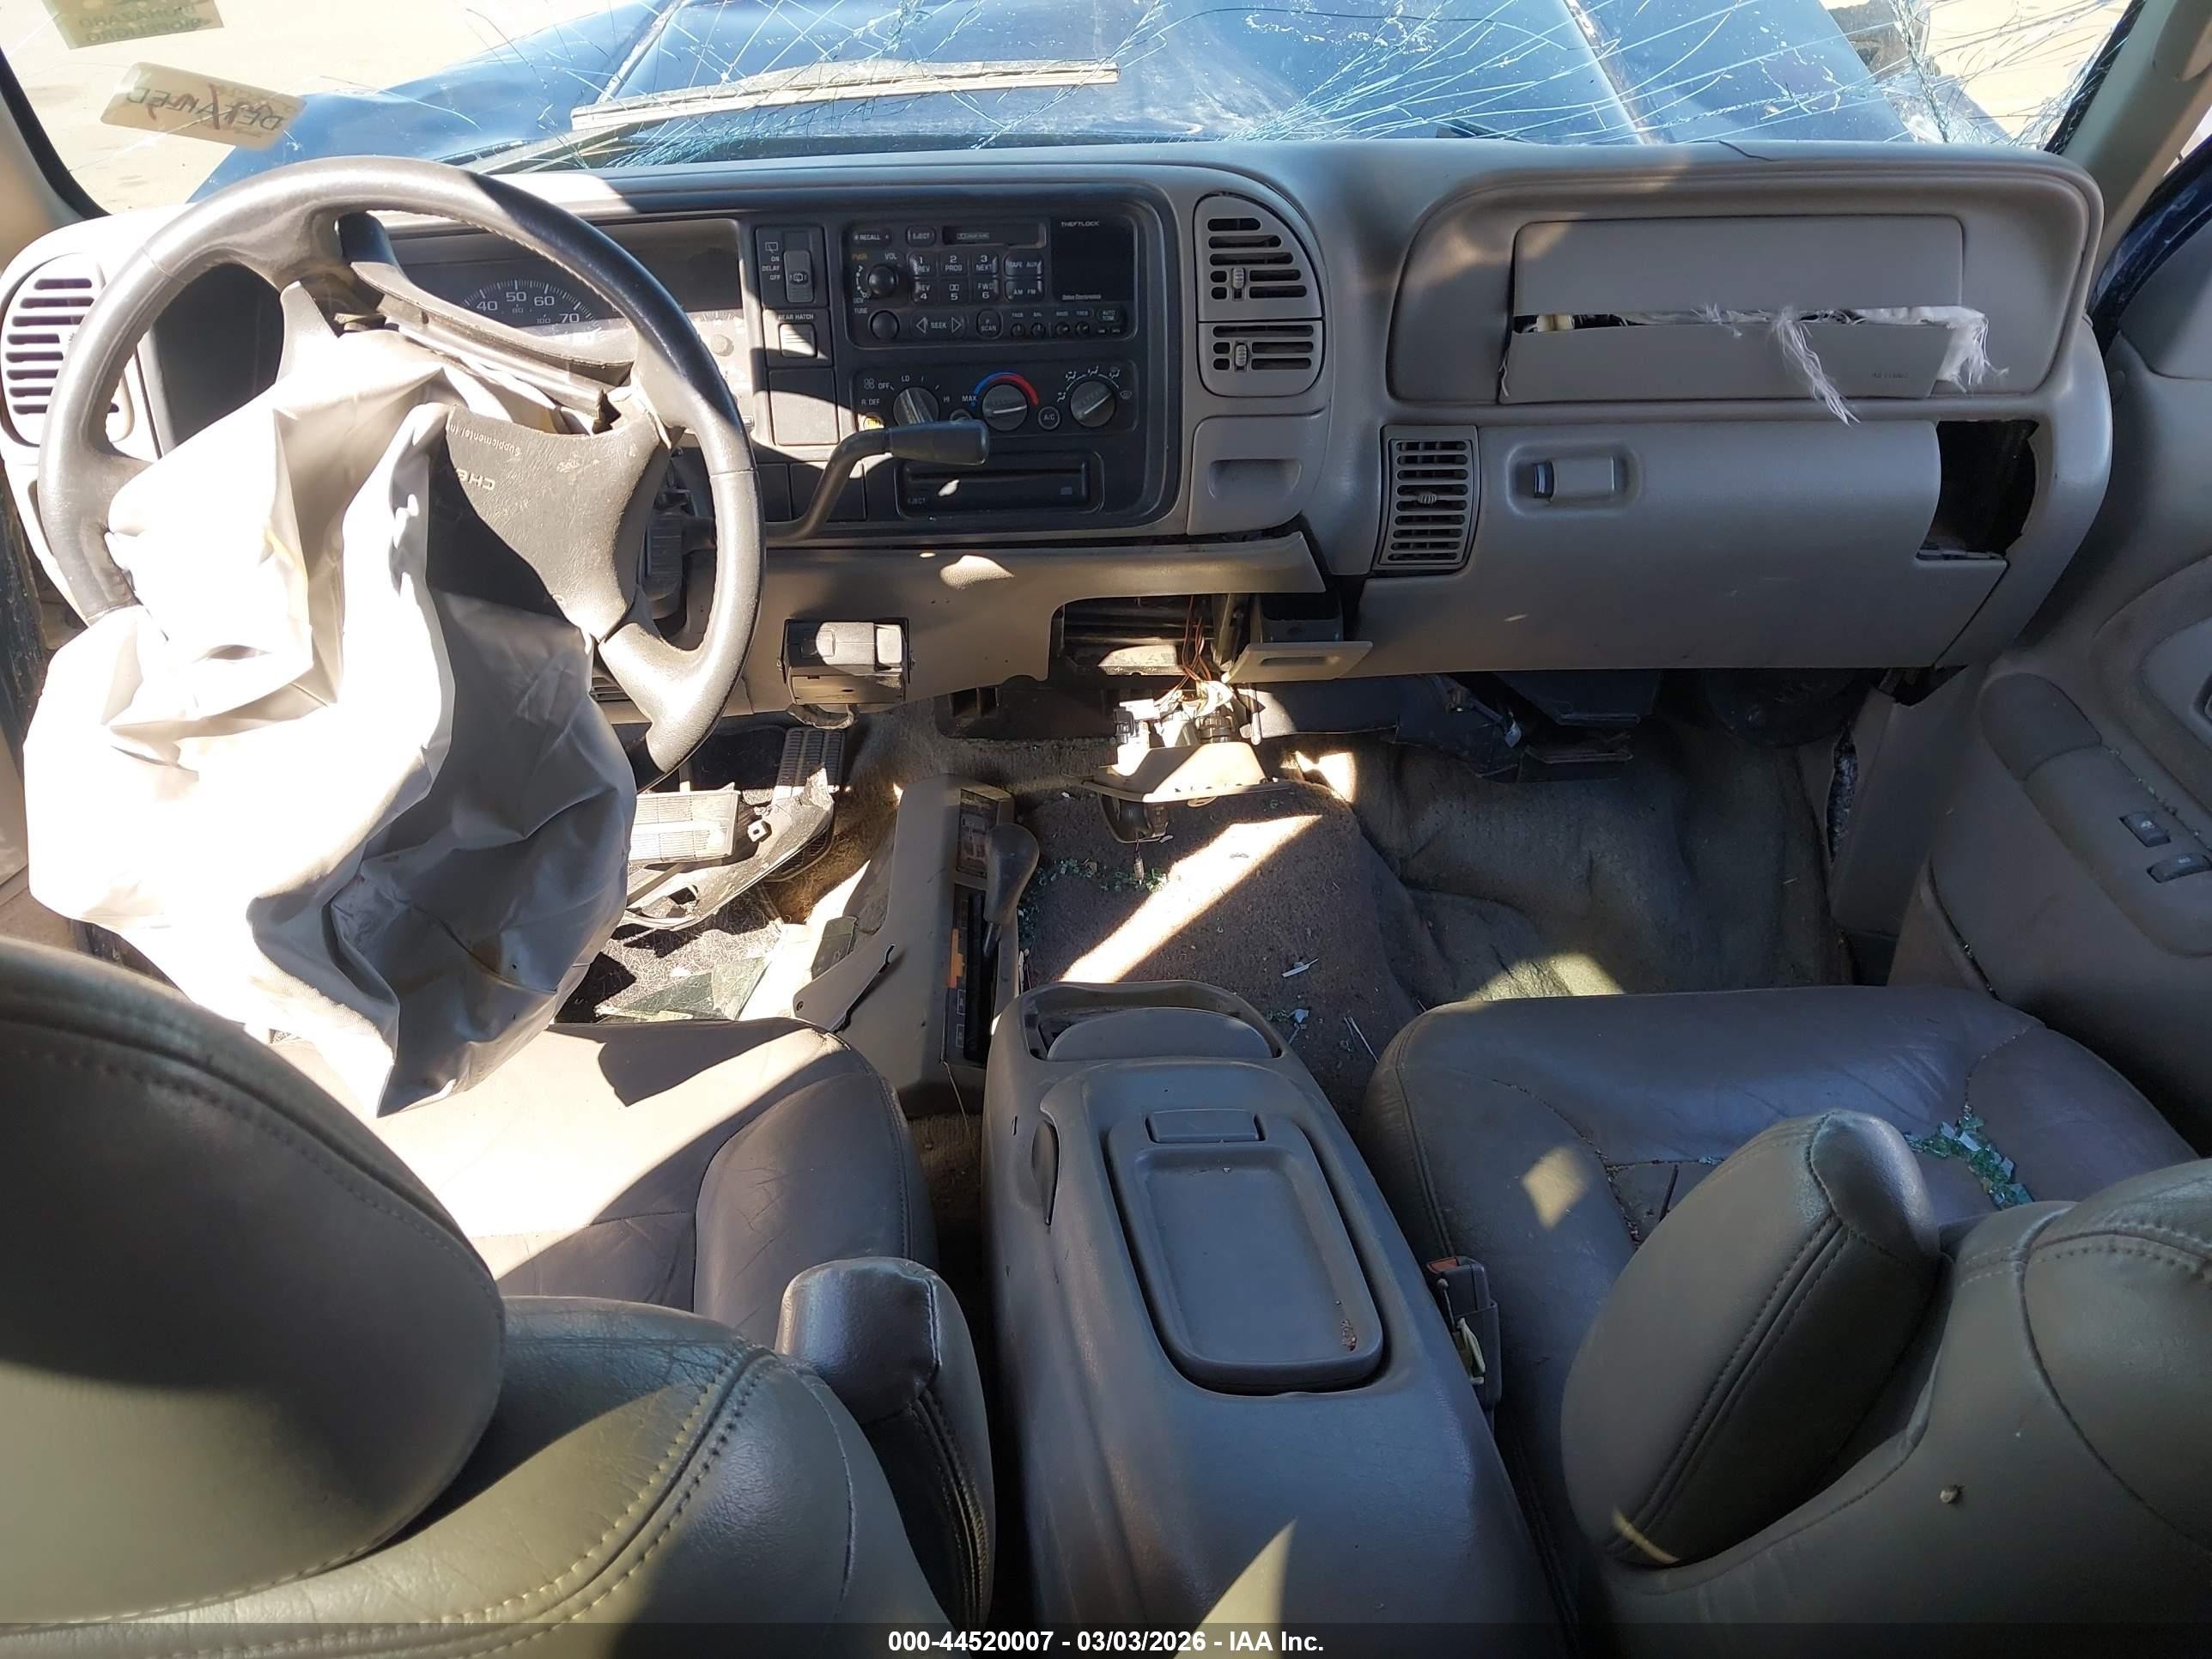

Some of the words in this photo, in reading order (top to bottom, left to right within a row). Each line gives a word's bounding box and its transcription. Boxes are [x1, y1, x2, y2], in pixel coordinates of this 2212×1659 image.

[950, 255, 957, 264] 2
[505, 291, 527, 302] 50
[533, 295, 555, 307] 60
[476, 301, 498, 311] 40
[559, 313, 580, 323] 70
